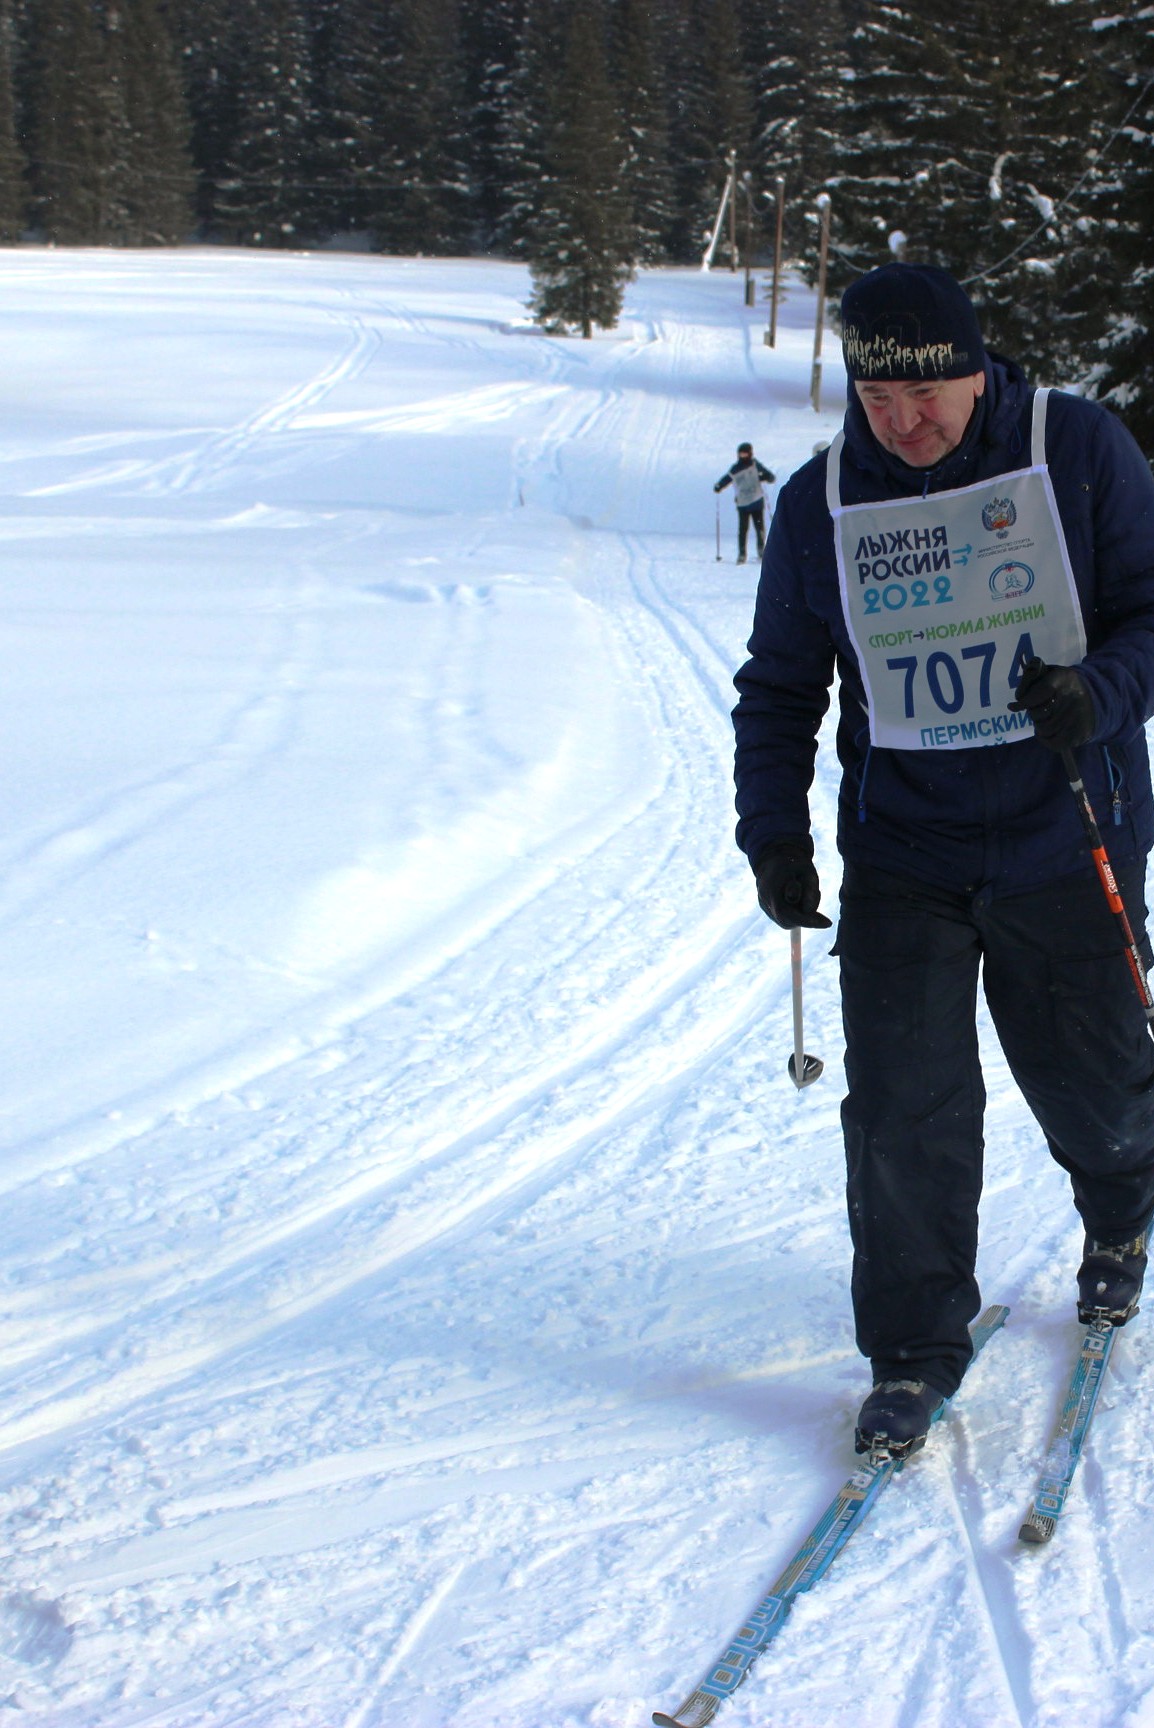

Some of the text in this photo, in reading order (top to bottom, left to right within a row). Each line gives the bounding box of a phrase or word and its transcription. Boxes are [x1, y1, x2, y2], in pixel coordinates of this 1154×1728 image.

[854, 525, 948, 560] ЛЫЖНЯ
[858, 549, 951, 584] РОССИИ
[863, 576, 954, 615] 2022
[869, 603, 1045, 648] СПОРТ НОРМА ЖИЗНИ
[886, 632, 1035, 718] 7074
